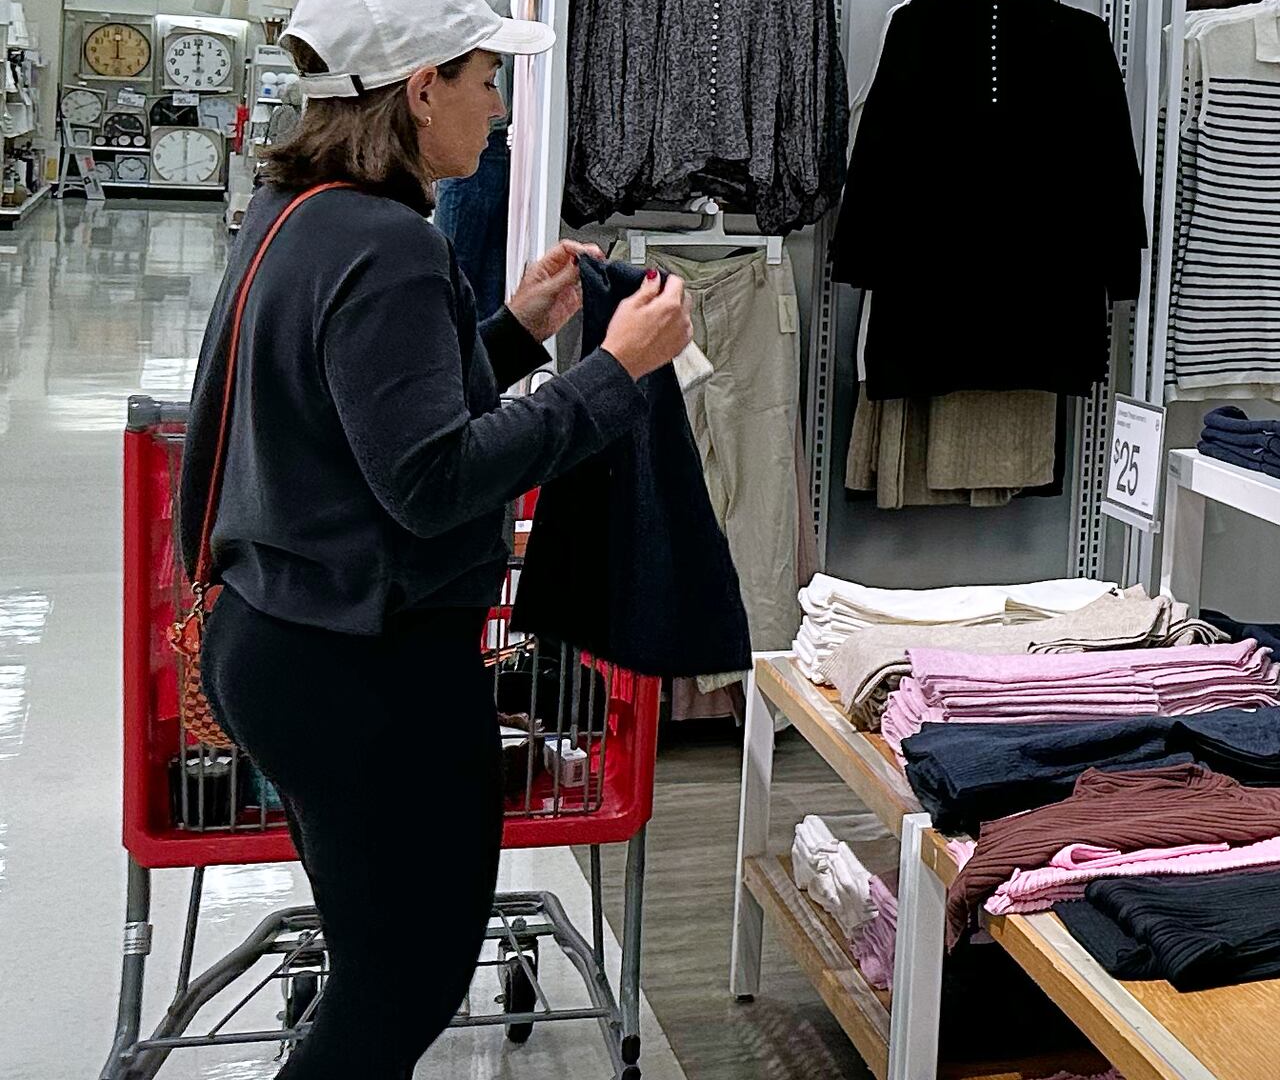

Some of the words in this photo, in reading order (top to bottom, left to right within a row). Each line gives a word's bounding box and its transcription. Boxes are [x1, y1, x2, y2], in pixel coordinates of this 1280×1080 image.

[216, 49, 222, 57] 2
[220, 59, 226, 67] 3
[207, 76, 213, 84] 5
[1113, 438, 1140, 496] $25
